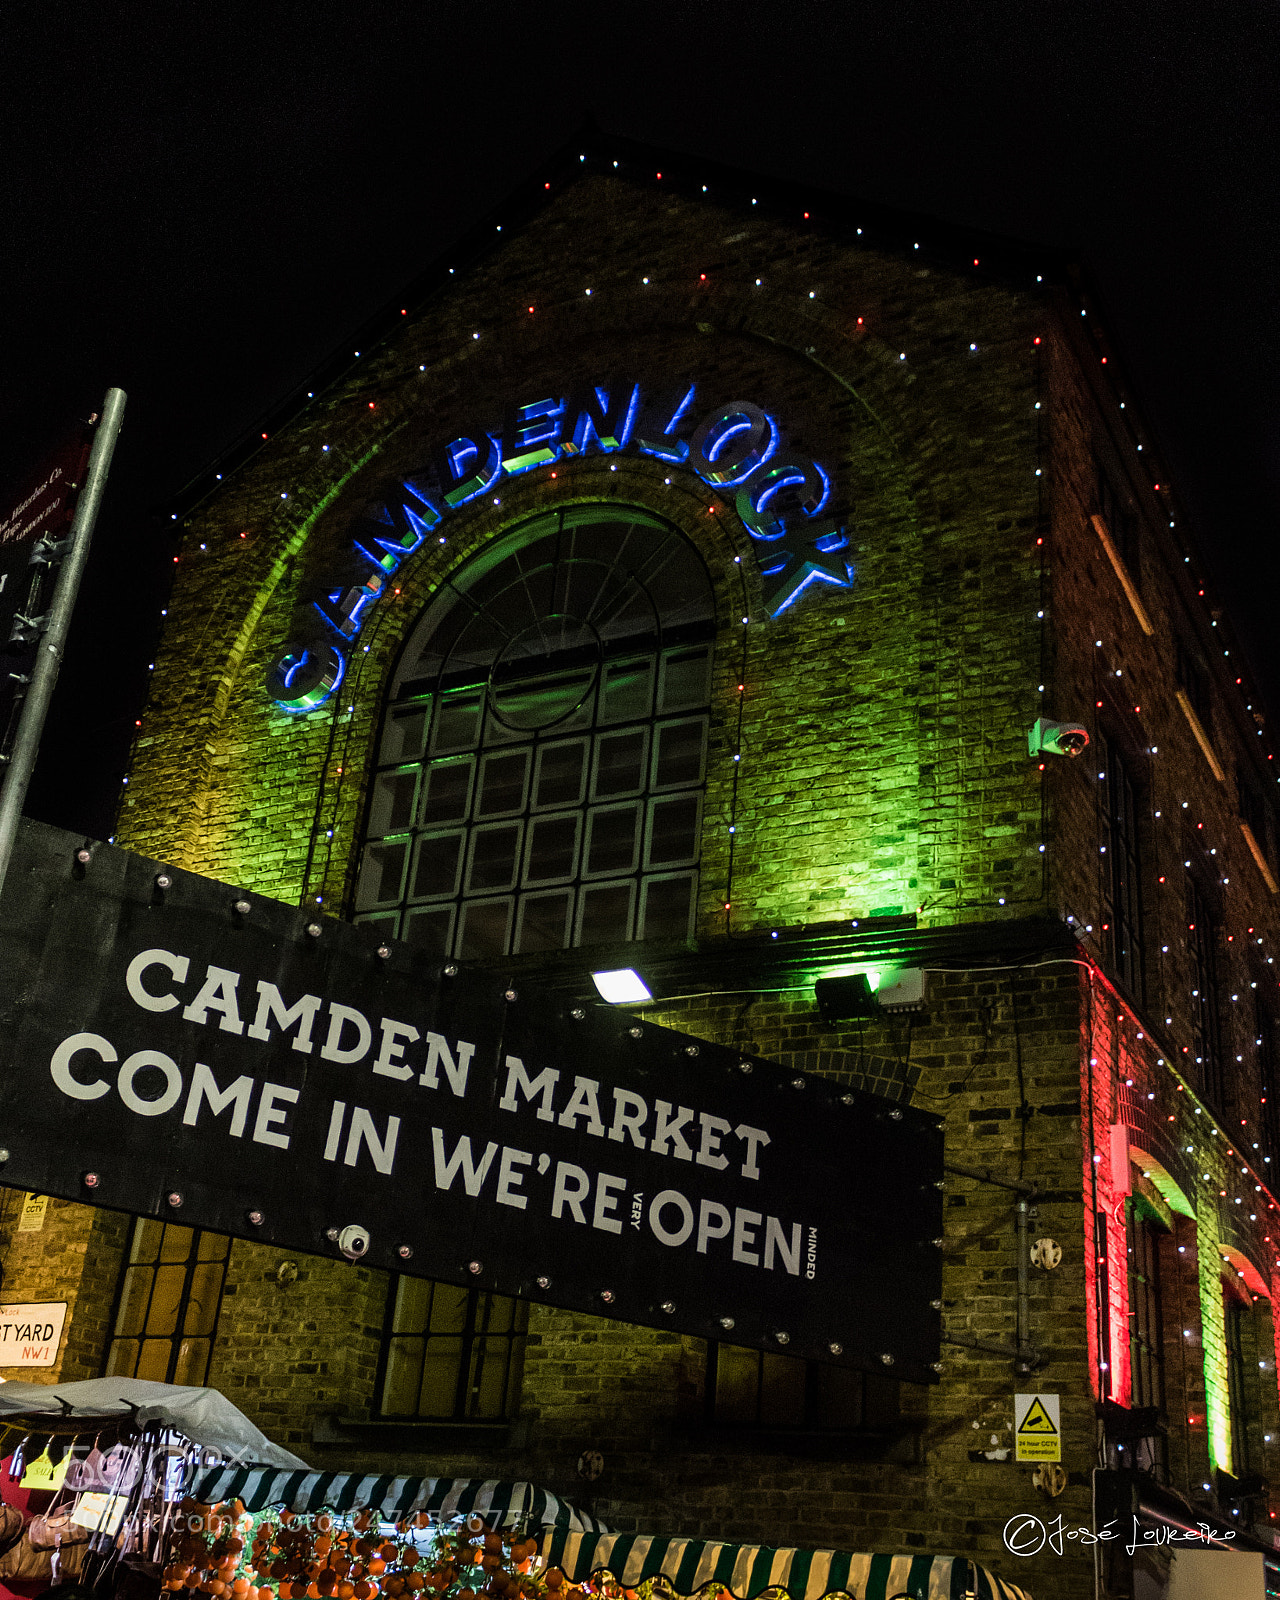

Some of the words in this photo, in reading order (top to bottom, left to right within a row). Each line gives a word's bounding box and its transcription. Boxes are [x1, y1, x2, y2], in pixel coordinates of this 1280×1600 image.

[264, 383, 641, 714] CAMDEN
[633, 382, 855, 620] LOCK
[126, 949, 476, 1097] CAMDEN
[500, 1055, 771, 1181] MARKET
[26, 1205, 43, 1213] CCTV
[50, 1032, 300, 1150] COME
[323, 1100, 401, 1176] IN
[432, 1127, 627, 1235] WE'RE
[629, 1192, 644, 1232] VERY
[649, 1189, 802, 1277] OPEN
[805, 1226, 818, 1281] MINDED
[0, 1323, 54, 1342] TYARD
[21, 1346, 50, 1361] NW1
